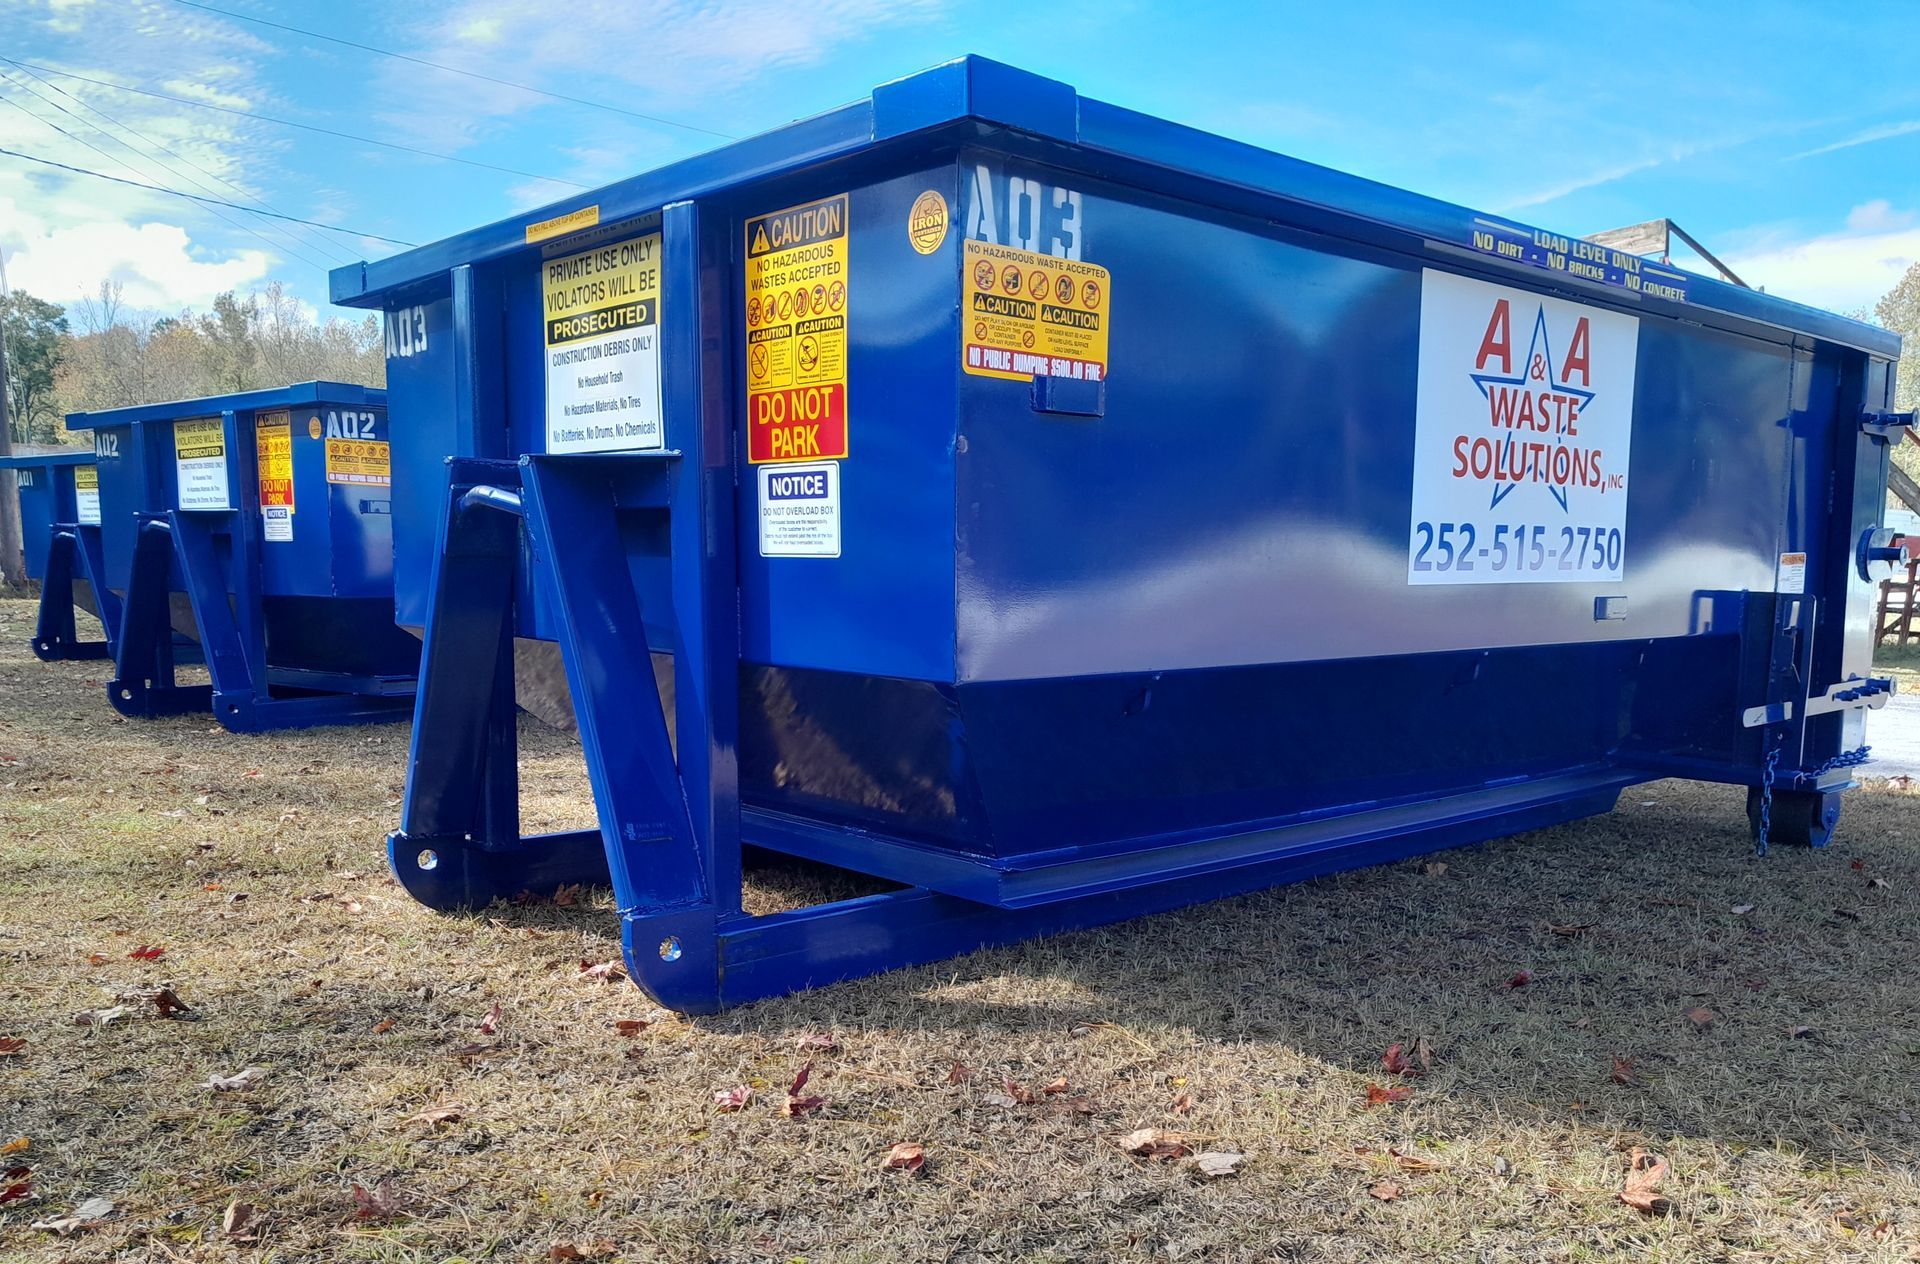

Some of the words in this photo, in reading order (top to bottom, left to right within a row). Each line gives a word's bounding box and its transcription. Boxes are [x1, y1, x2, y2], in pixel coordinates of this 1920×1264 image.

[771, 203, 840, 248] CAUTION
[914, 214, 942, 230] IRON
[966, 165, 1082, 262] A03
[549, 256, 592, 285] PRIVATE
[595, 248, 618, 273] USE
[621, 239, 653, 267] ONLY
[756, 258, 770, 274] NO
[772, 244, 834, 271] HAZARDOUS
[966, 243, 980, 254] NO
[982, 246, 1035, 266] HAZARDOUS
[1036, 256, 1064, 272] WASTE
[1066, 264, 1106, 279] ACCEPTED
[1473, 231, 1494, 251] NO
[1497, 240, 1524, 259] DIRT
[1546, 252, 1564, 271] NO
[1568, 260, 1605, 280] BRICKS
[1624, 272, 1640, 291] NO
[1642, 281, 1686, 301] CONCRETE
[1534, 229, 1568, 254] LOAD
[1572, 241, 1608, 265] LEVEL
[1612, 251, 1642, 274] ONLY
[546, 281, 606, 313] VIOLATORS
[608, 274, 636, 298] WILL
[639, 268, 656, 292] BE
[750, 272, 786, 292] WASTES
[788, 261, 841, 285] ACCEPTED
[553, 304, 648, 340] PROSECUTED
[986, 297, 1035, 319] CAUTION
[1052, 308, 1098, 329] CAUTION
[386, 305, 428, 359] A03
[756, 326, 790, 341] CAUTION
[804, 317, 842, 333] CAUTION
[552, 345, 602, 367] CONSTRUCTION
[604, 339, 630, 358] DEBRIS
[632, 334, 652, 352] ONLY
[1474, 298, 1512, 374] A
[1530, 353, 1546, 382] &
[1560, 316, 1590, 387] A
[969, 346, 980, 367] NO
[983, 348, 1011, 371] PUBLIC
[1013, 354, 1048, 376] DUMPING
[1050, 358, 1083, 380] $500.00
[1085, 364, 1101, 382] FINE
[578, 376, 584, 389] No
[585, 373, 609, 388] Household
[610, 370, 624, 384] Trash
[564, 405, 571, 417] No
[571, 402, 595, 416] Hazardous
[595, 398, 620, 412] Materials,
[620, 397, 628, 409] No
[628, 396, 641, 409] Tires
[758, 393, 786, 426] DO
[791, 386, 834, 422] NOT
[1488, 385, 1580, 436] WASTE
[176, 424, 196, 434] PRIVATE
[198, 422, 207, 432] USE
[208, 421, 222, 431] ONLY
[176, 435, 202, 446] VIOLATORS
[203, 434, 215, 444] WILL
[216, 433, 223, 442] BE
[326, 411, 376, 439] A02
[553, 430, 560, 443] No
[561, 428, 586, 443] Batteries,
[586, 426, 594, 440] No
[595, 426, 615, 440] Drums,
[615, 423, 624, 437] No
[624, 420, 656, 436] Chemicals
[96, 433, 119, 458] A02
[180, 448, 221, 458] PROSECUTED
[770, 424, 821, 458] PARK
[18, 470, 34, 487] A01
[1452, 435, 1606, 494] SOLUTIONS,
[1608, 474, 1624, 489] INC
[262, 480, 273, 492] DO
[274, 480, 289, 492] NOT
[268, 493, 286, 505] PARK
[772, 475, 824, 497] NOTICE
[267, 510, 286, 518] NOTICE
[762, 508, 772, 516] DO
[772, 507, 785, 516] NOT
[786, 506, 819, 516] OVERLOAD
[820, 506, 834, 515] BOX
[1413, 521, 1622, 572] 252-515-2750
